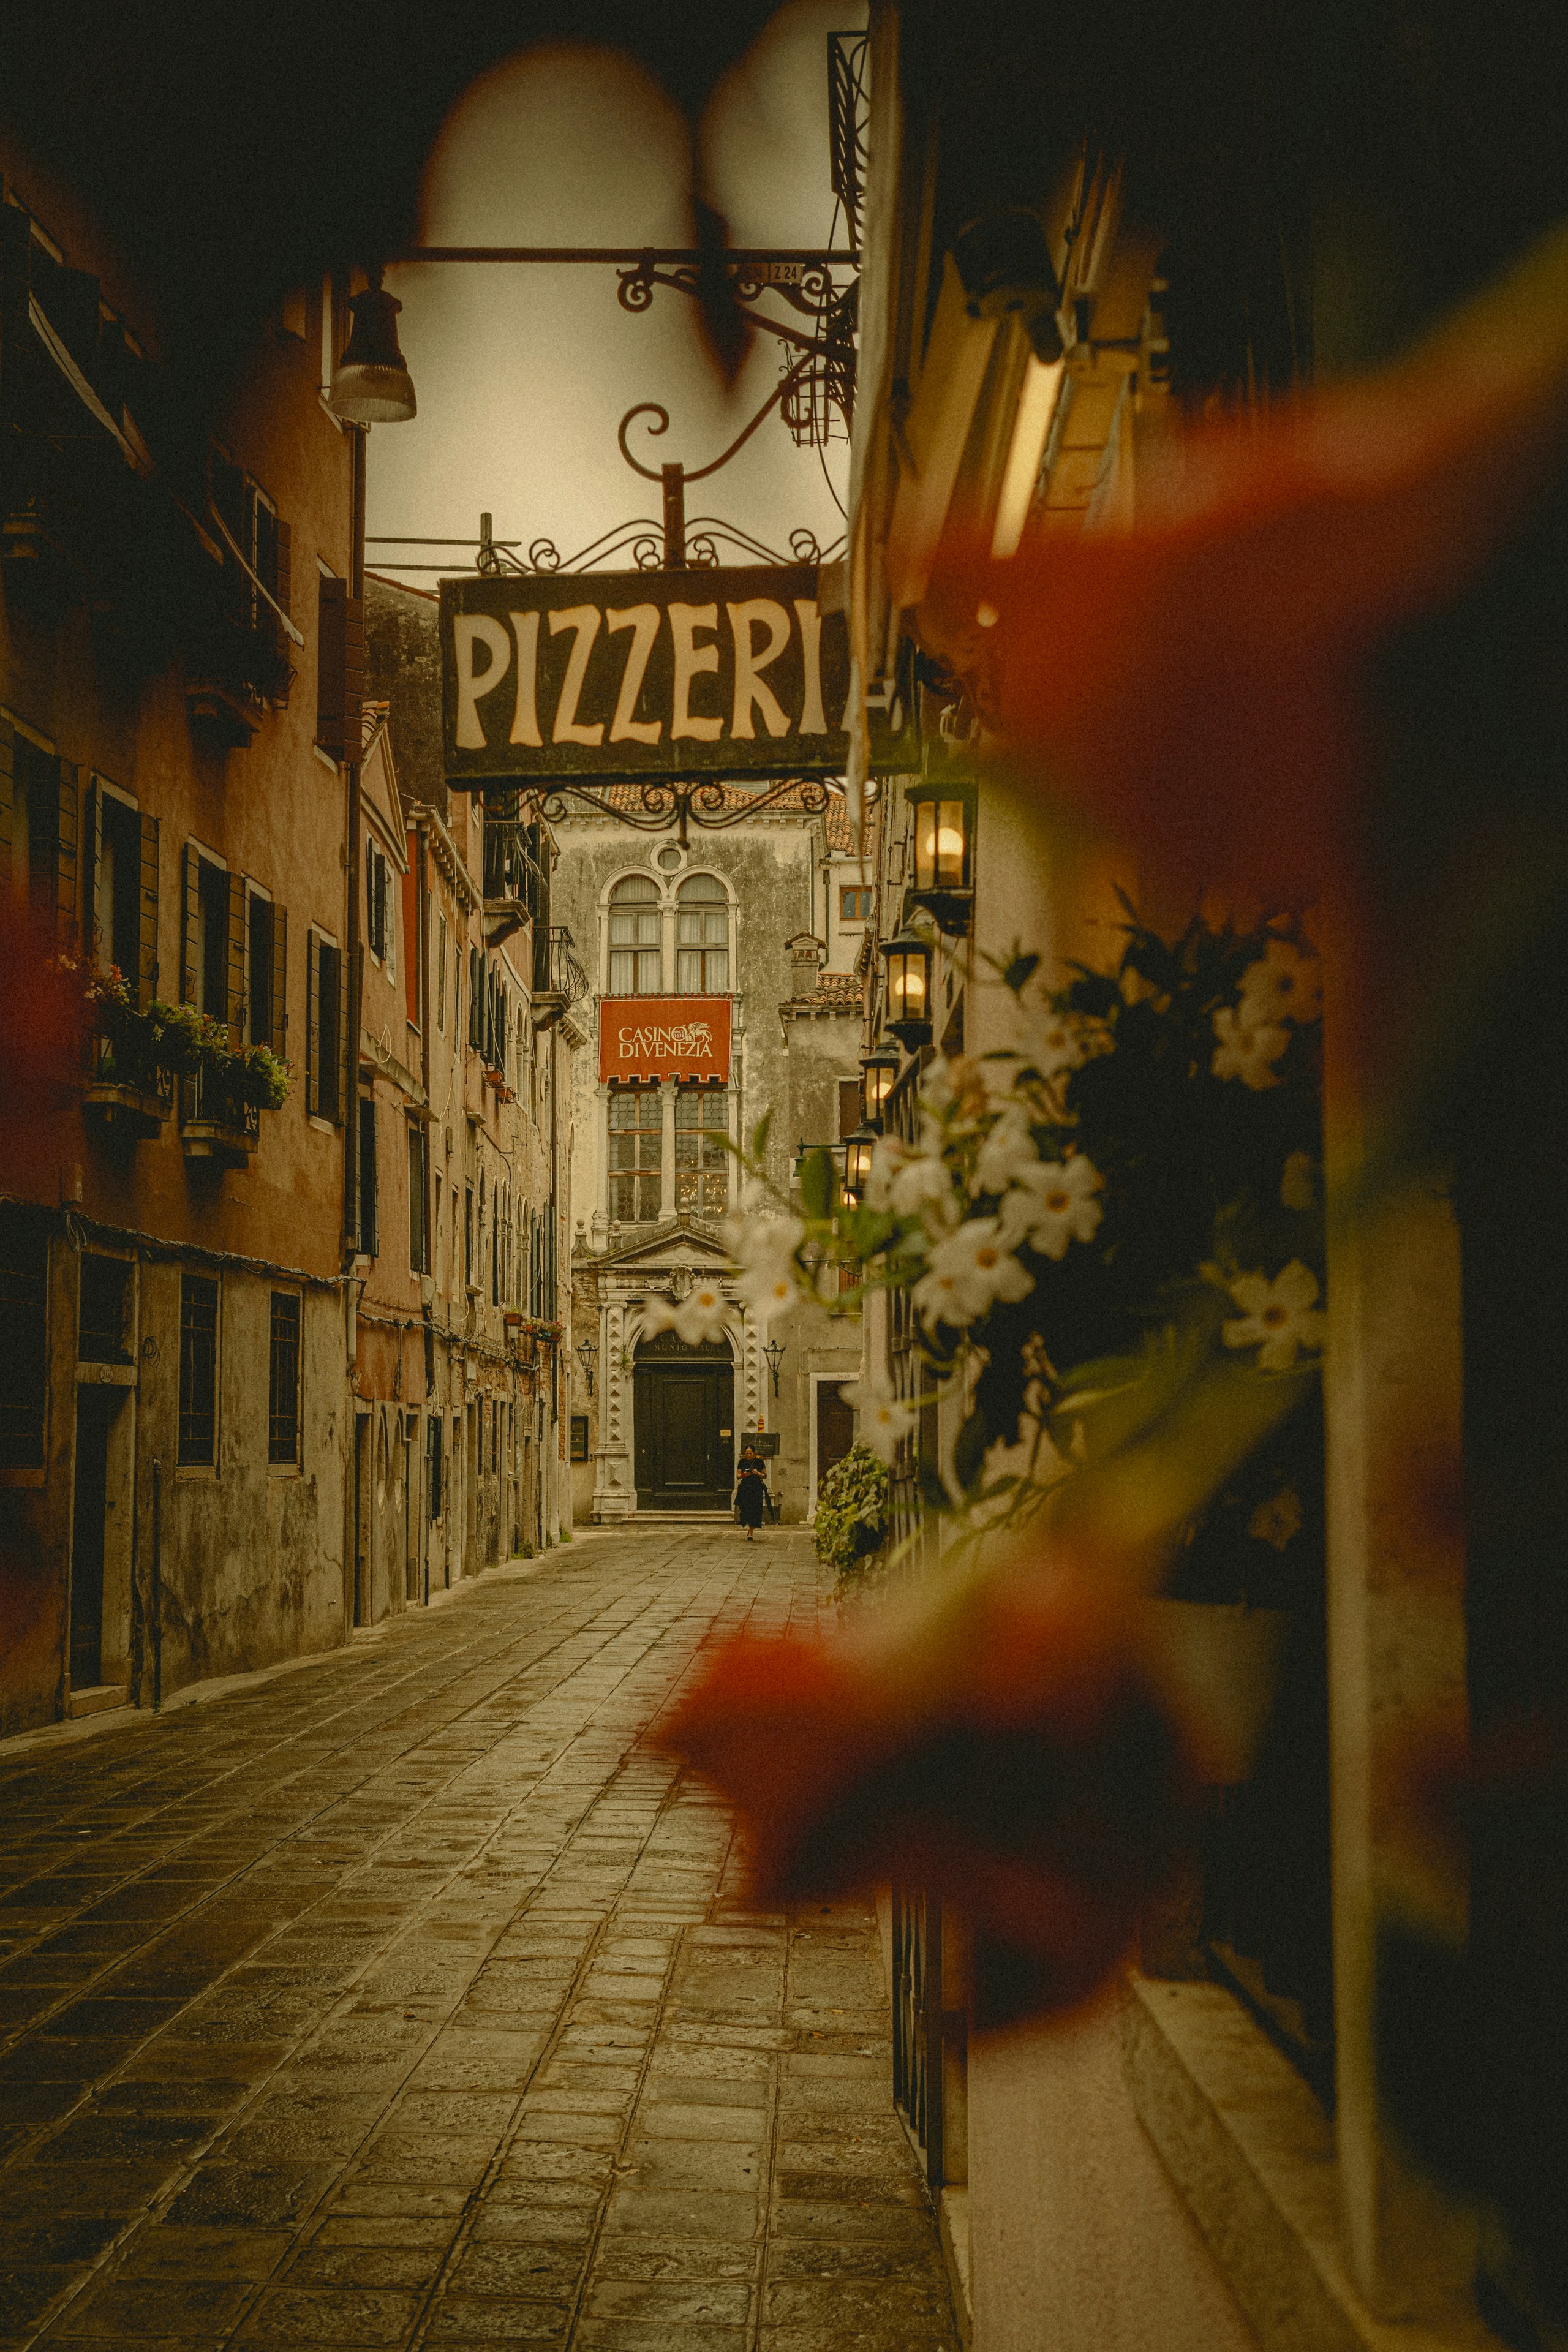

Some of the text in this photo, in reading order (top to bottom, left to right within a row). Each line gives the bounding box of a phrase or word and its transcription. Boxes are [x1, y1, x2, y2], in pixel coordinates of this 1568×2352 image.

[785, 266, 797, 279] 24
[618, 1041, 713, 1058] DI VENEZIA
